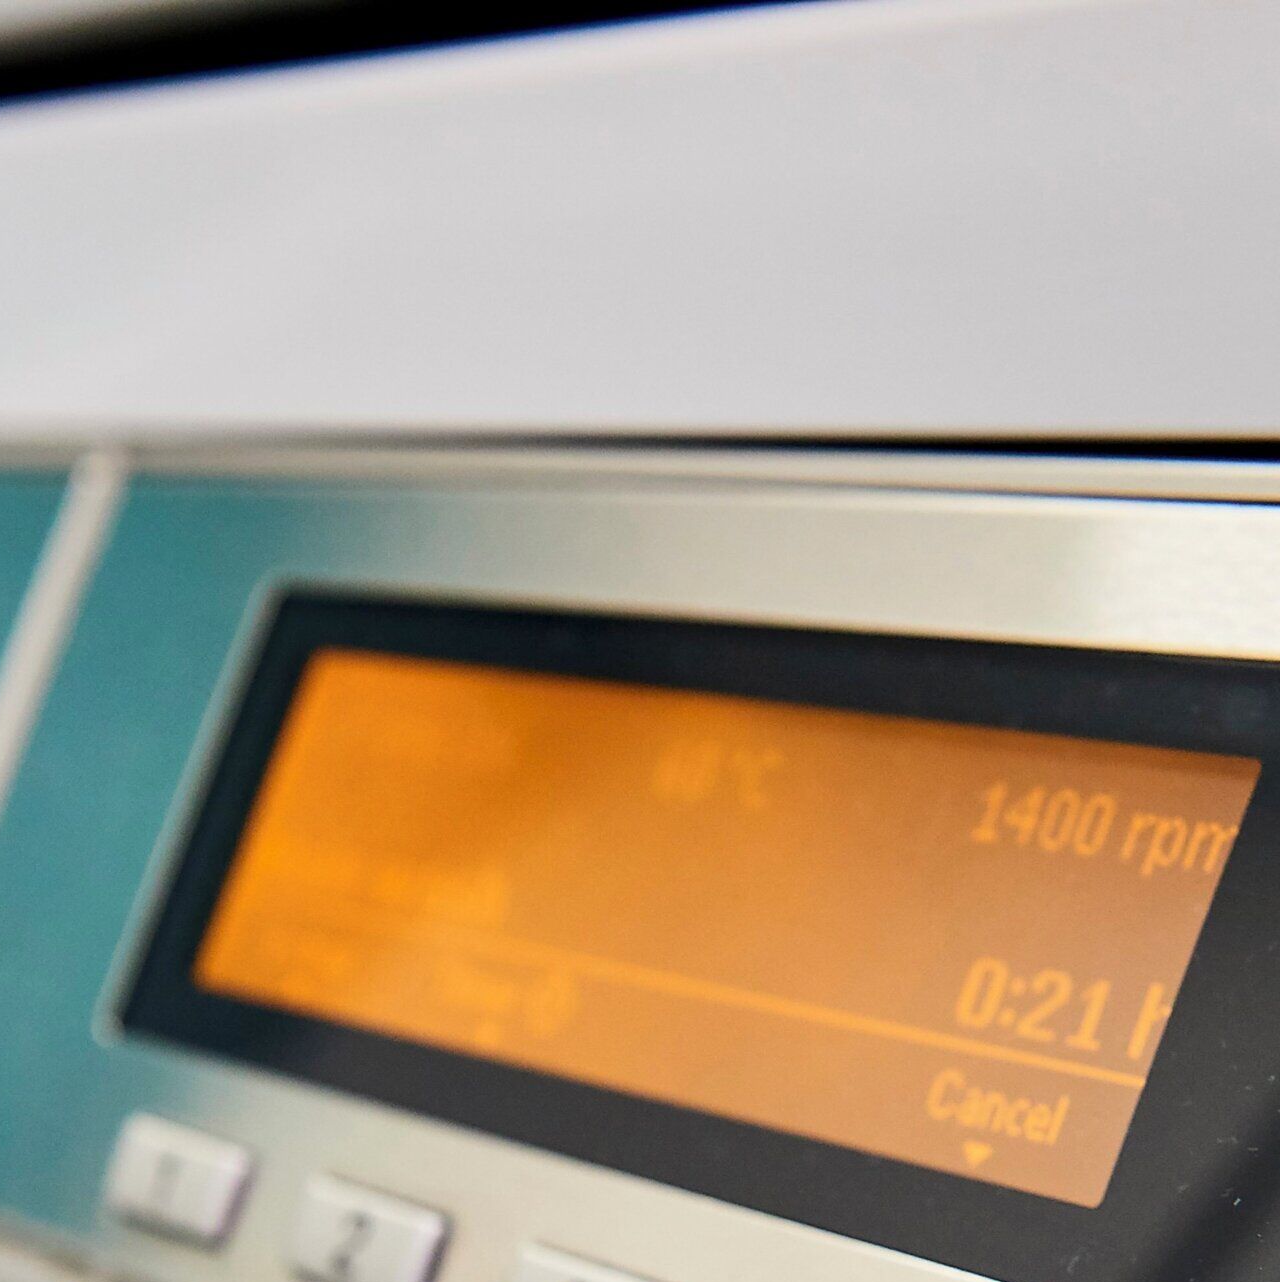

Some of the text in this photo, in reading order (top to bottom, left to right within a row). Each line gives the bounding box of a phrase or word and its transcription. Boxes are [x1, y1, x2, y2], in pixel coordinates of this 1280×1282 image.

[971, 782, 1238, 878] 1400 rpm
[955, 960, 1112, 1052] 0:21
[926, 1067, 1070, 1146] Cancel
[331, 1208, 377, 1279] 2
